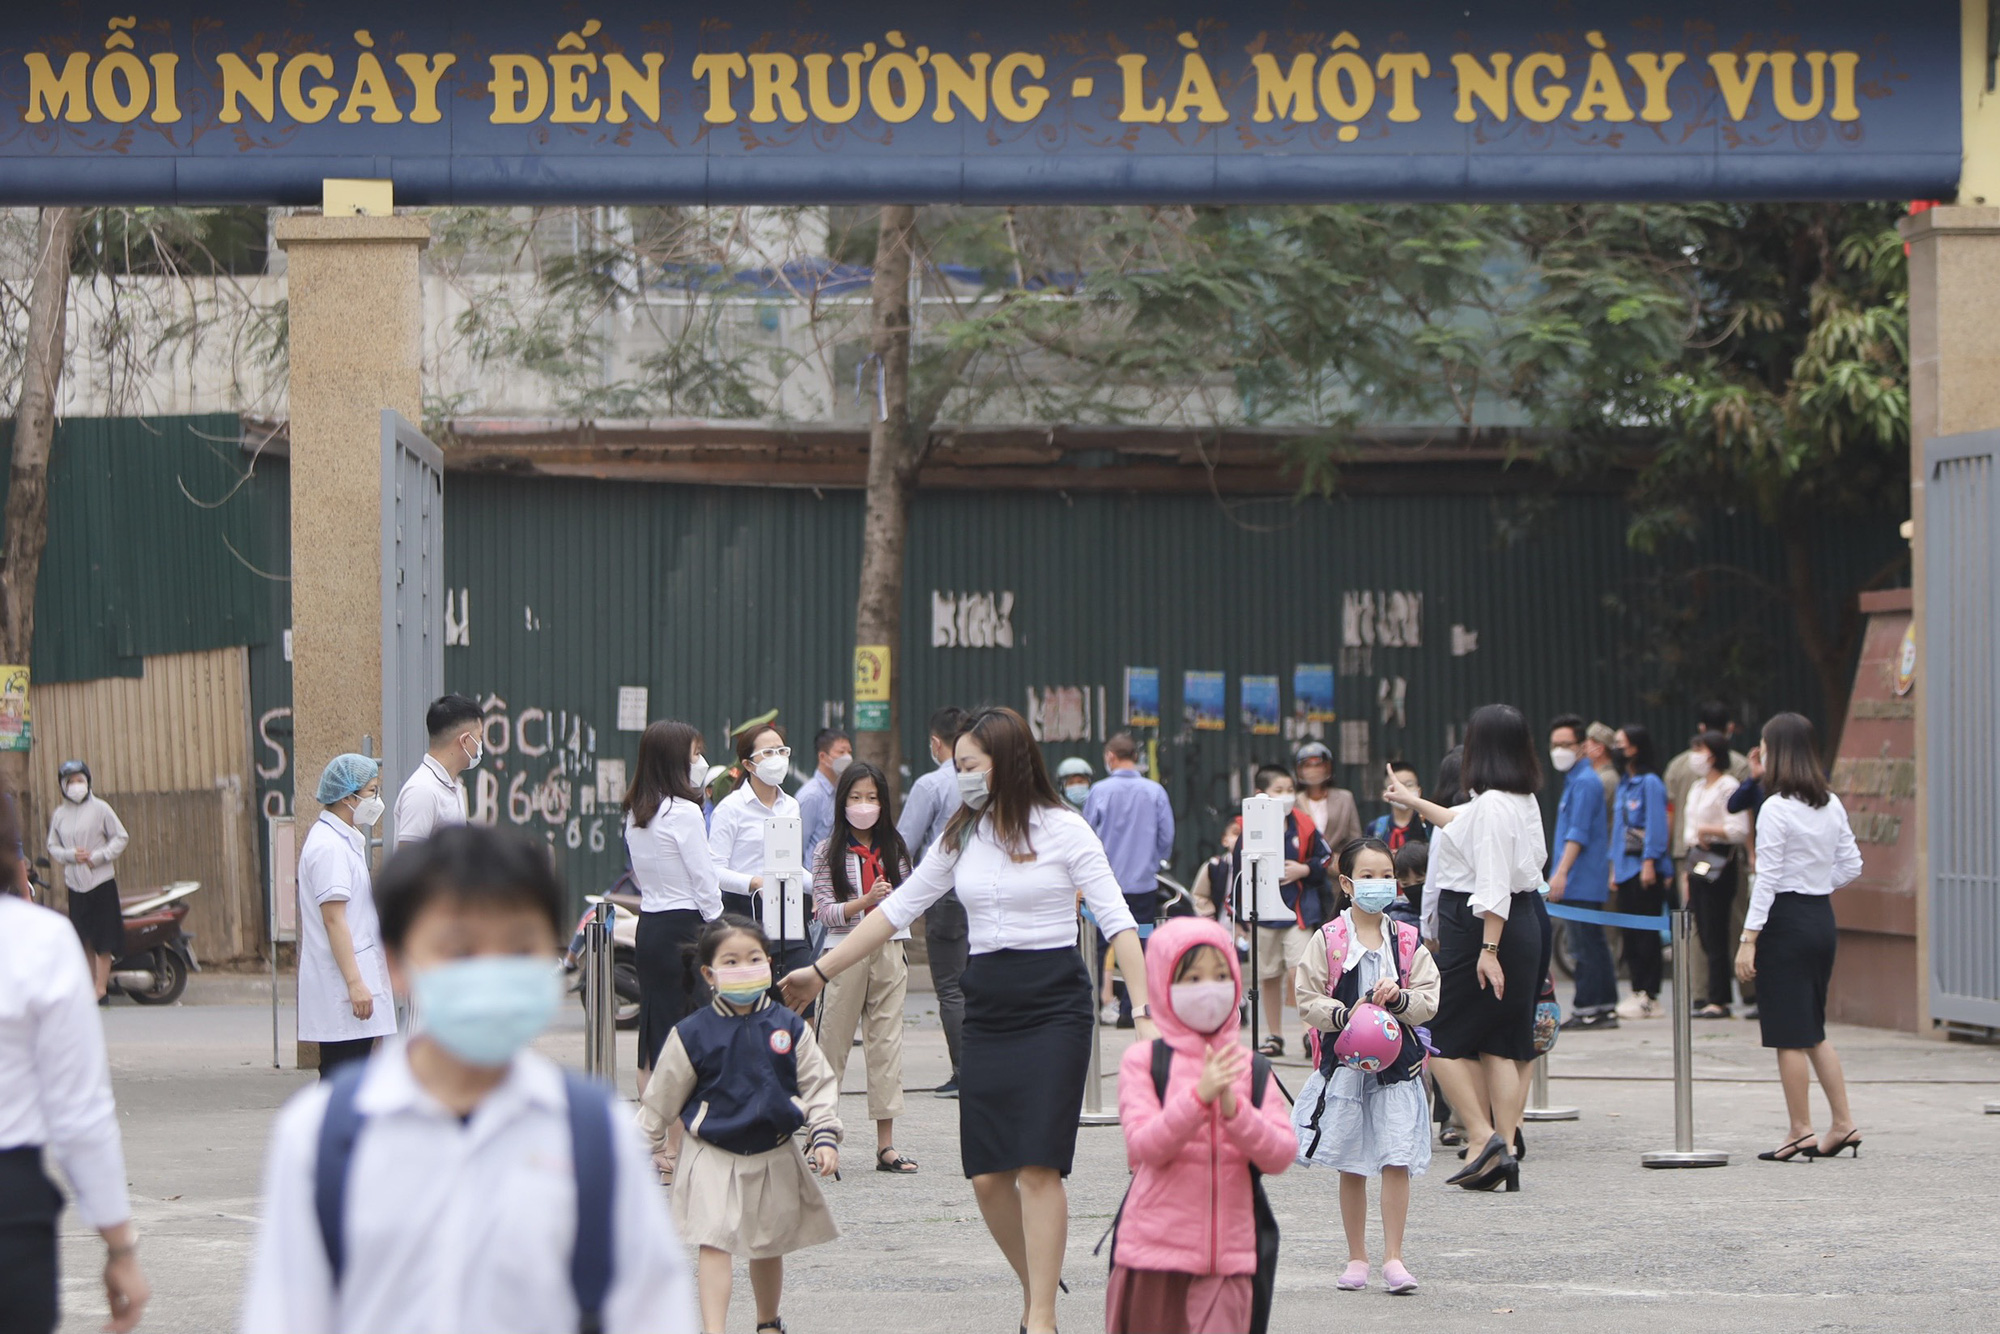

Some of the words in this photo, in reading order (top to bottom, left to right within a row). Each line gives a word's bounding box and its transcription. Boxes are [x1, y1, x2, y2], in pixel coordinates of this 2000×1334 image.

[24, 16, 182, 124] MỖI
[216, 30, 456, 124] NGÀY
[487, 20, 665, 124] ĐẾN
[692, 31, 1050, 124] TRƯỜNG
[1116, 32, 1229, 123] LÀ
[1252, 31, 1430, 142] MỘT
[1451, 31, 1685, 123] NGÀY
[1707, 52, 1861, 122] VUI
